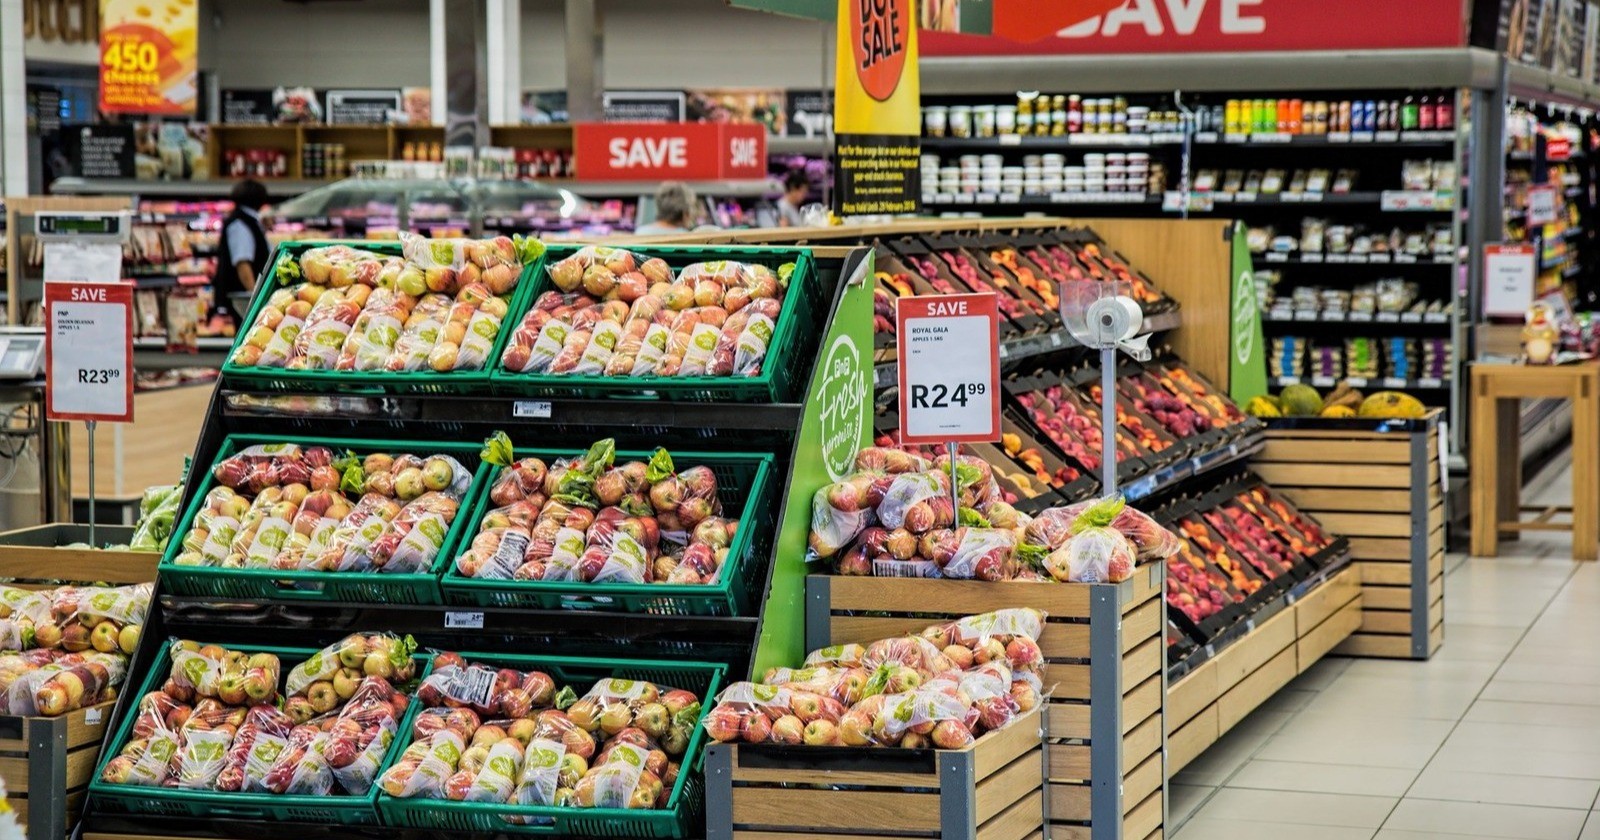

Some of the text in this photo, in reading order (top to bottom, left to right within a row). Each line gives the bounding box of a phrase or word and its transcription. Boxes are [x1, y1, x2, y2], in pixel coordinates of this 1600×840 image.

[861, 10, 902, 70] SALE
[103, 42, 158, 72] 450
[609, 137, 688, 168] SAVE
[730, 137, 758, 168] SAVE
[71, 288, 107, 301] SAVE
[927, 301, 968, 316] SAVE
[816, 350, 868, 431] Fresh
